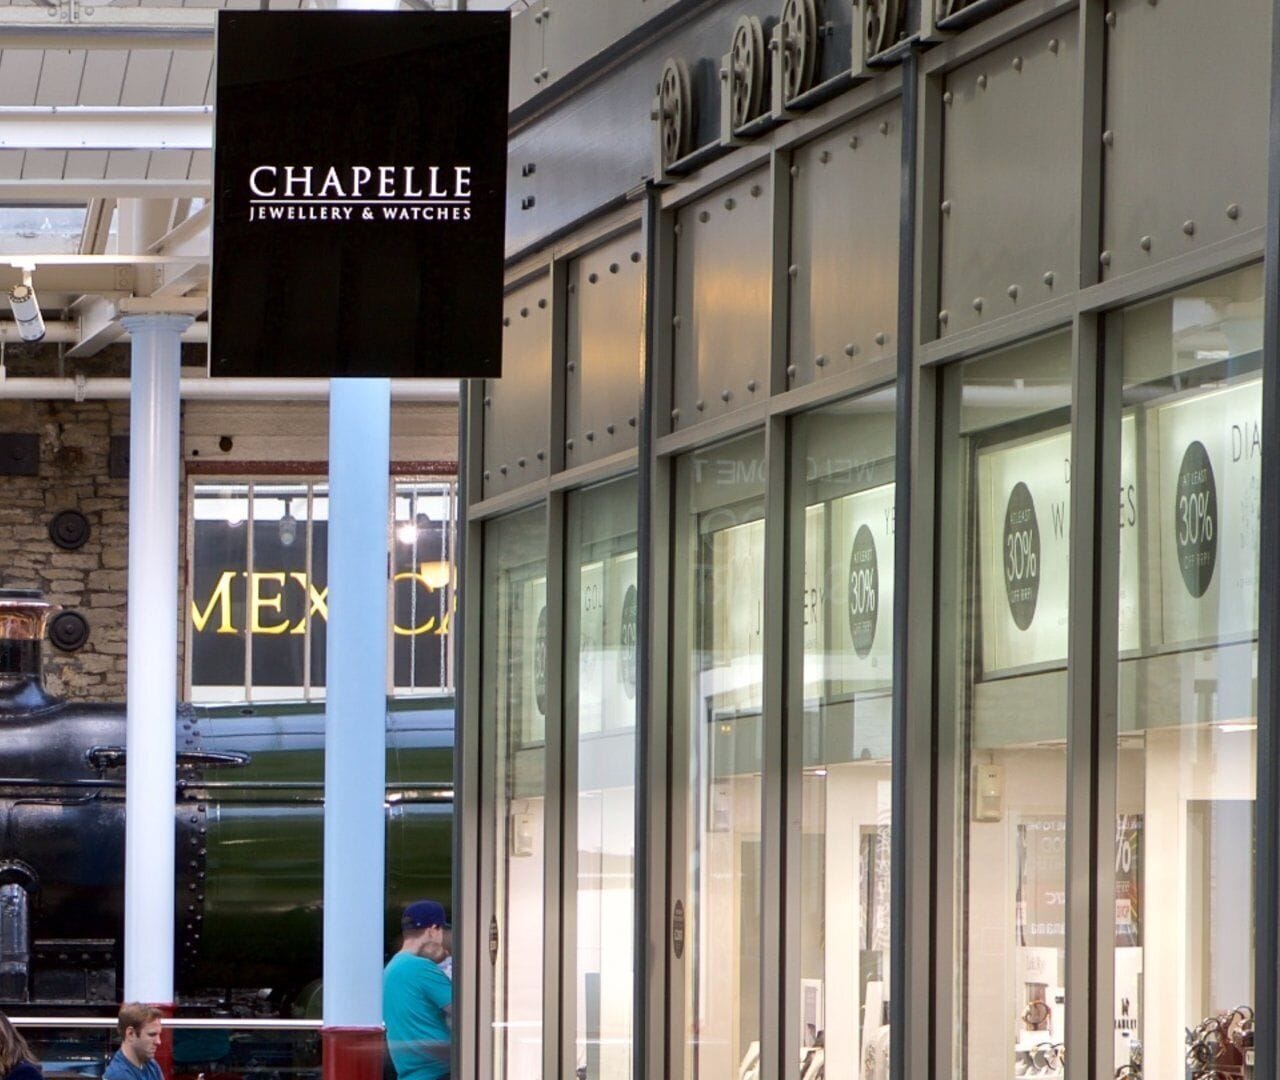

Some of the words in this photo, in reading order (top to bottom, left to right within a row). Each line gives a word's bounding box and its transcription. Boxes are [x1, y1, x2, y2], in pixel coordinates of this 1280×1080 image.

[249, 165, 471, 197] CHAPELLE
[249, 206, 353, 222] JEWELLERY
[362, 207, 374, 220] &
[382, 207, 471, 220] WATCHES
[1179, 490, 1213, 547] 30%
[1007, 528, 1037, 582] 30%
[851, 568, 876, 616] 30%
